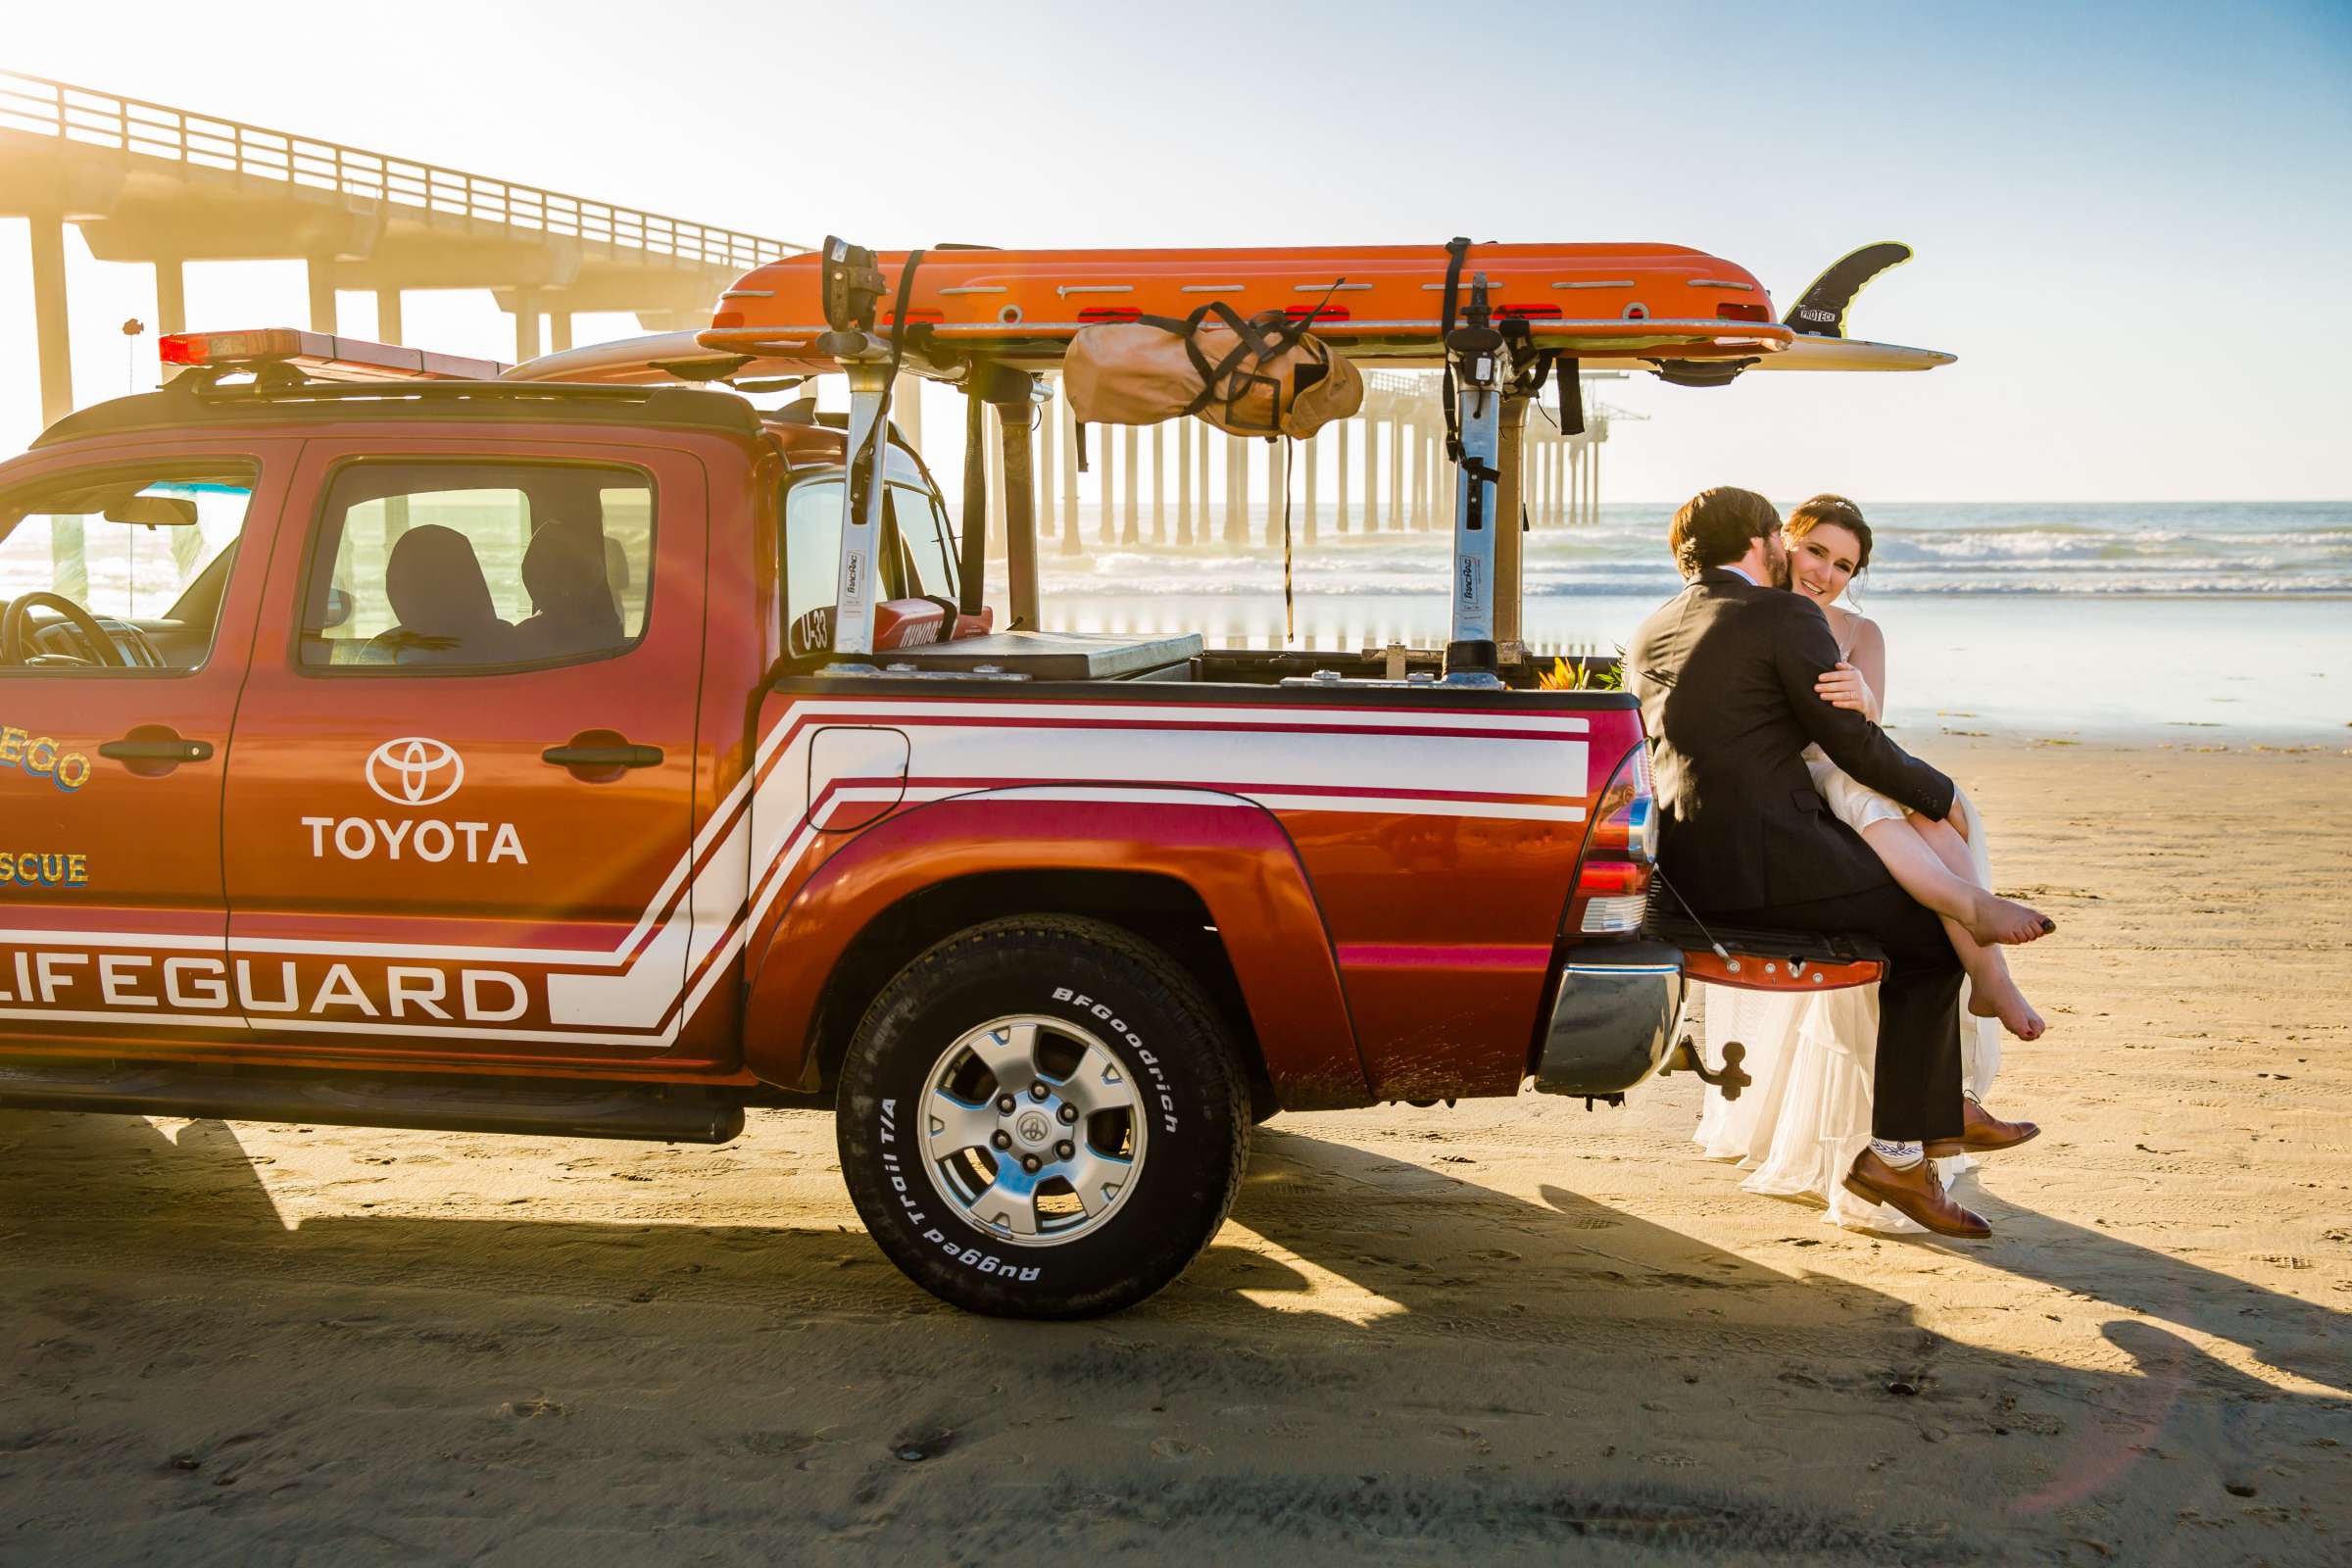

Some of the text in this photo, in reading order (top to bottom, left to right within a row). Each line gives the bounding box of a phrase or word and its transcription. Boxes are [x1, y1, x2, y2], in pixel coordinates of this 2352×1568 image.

[801, 609, 828, 651] U-33
[301, 816, 529, 864] TOYOTA
[0, 952, 528, 1021] IFEGUARD
[1052, 987, 1178, 1133] BFGoodrich
[880, 1099, 1041, 1281] Rugged Trail T/A
